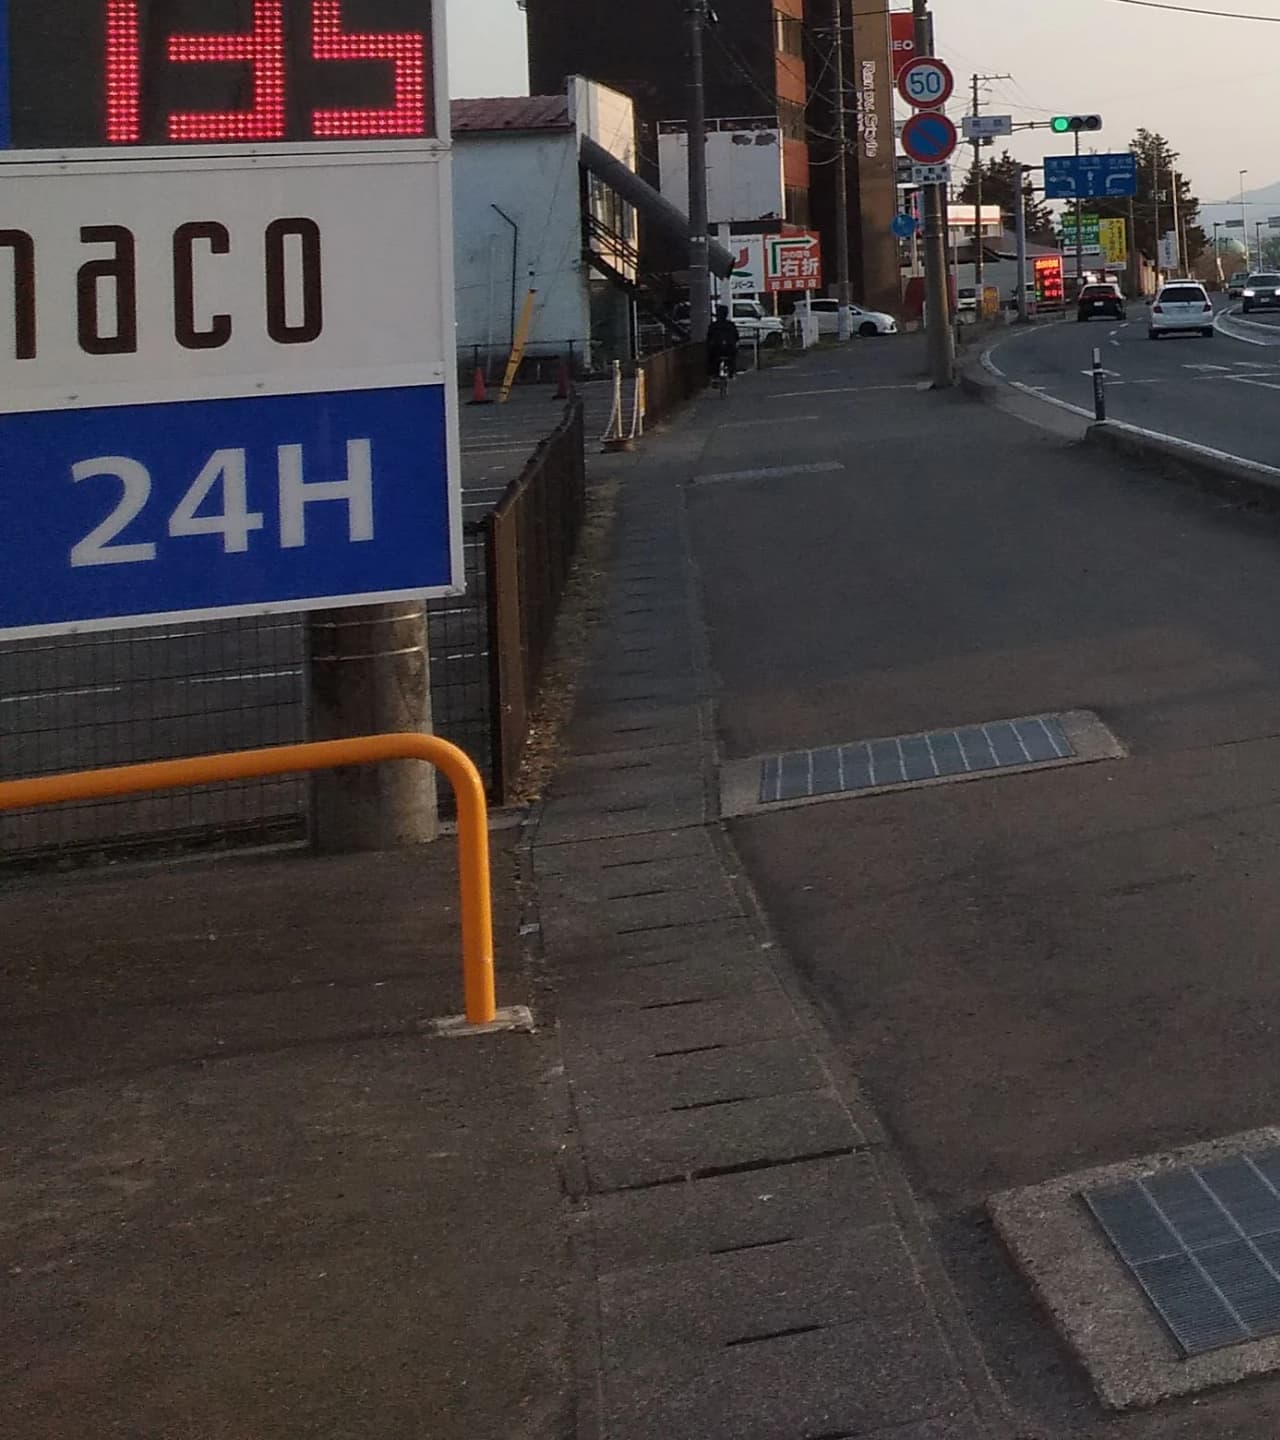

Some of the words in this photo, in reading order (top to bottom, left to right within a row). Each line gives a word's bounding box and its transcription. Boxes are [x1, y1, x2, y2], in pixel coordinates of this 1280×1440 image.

[892, 39, 914, 50] EO
[909, 71, 941, 95] 50
[782, 258, 819, 277] 右折
[70, 437, 375, 568] 24H
